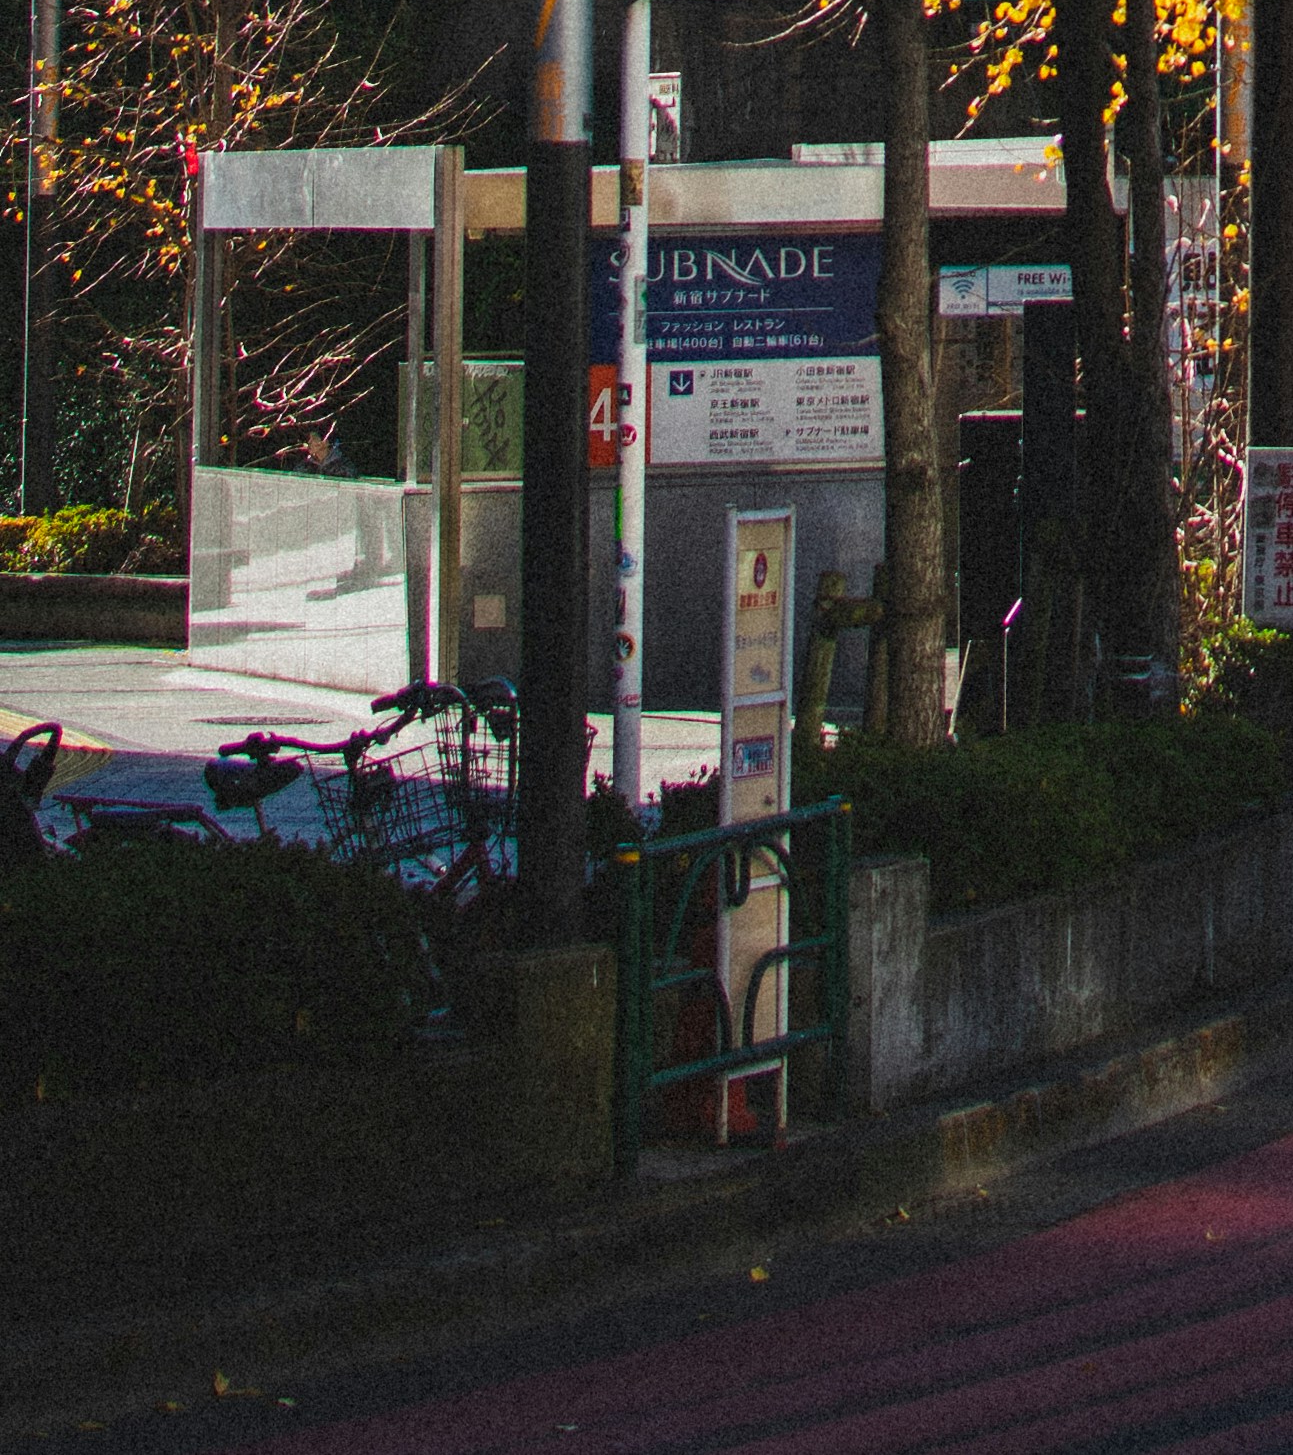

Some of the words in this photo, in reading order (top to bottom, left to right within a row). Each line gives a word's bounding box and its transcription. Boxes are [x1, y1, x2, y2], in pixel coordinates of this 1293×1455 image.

[1017, 272, 1046, 285] FREE
[672, 289, 771, 306] 新宿サブナード
[661, 320, 725, 334] ファッション
[733, 318, 786, 332] レストラン
[589, 387, 617, 442] 4
